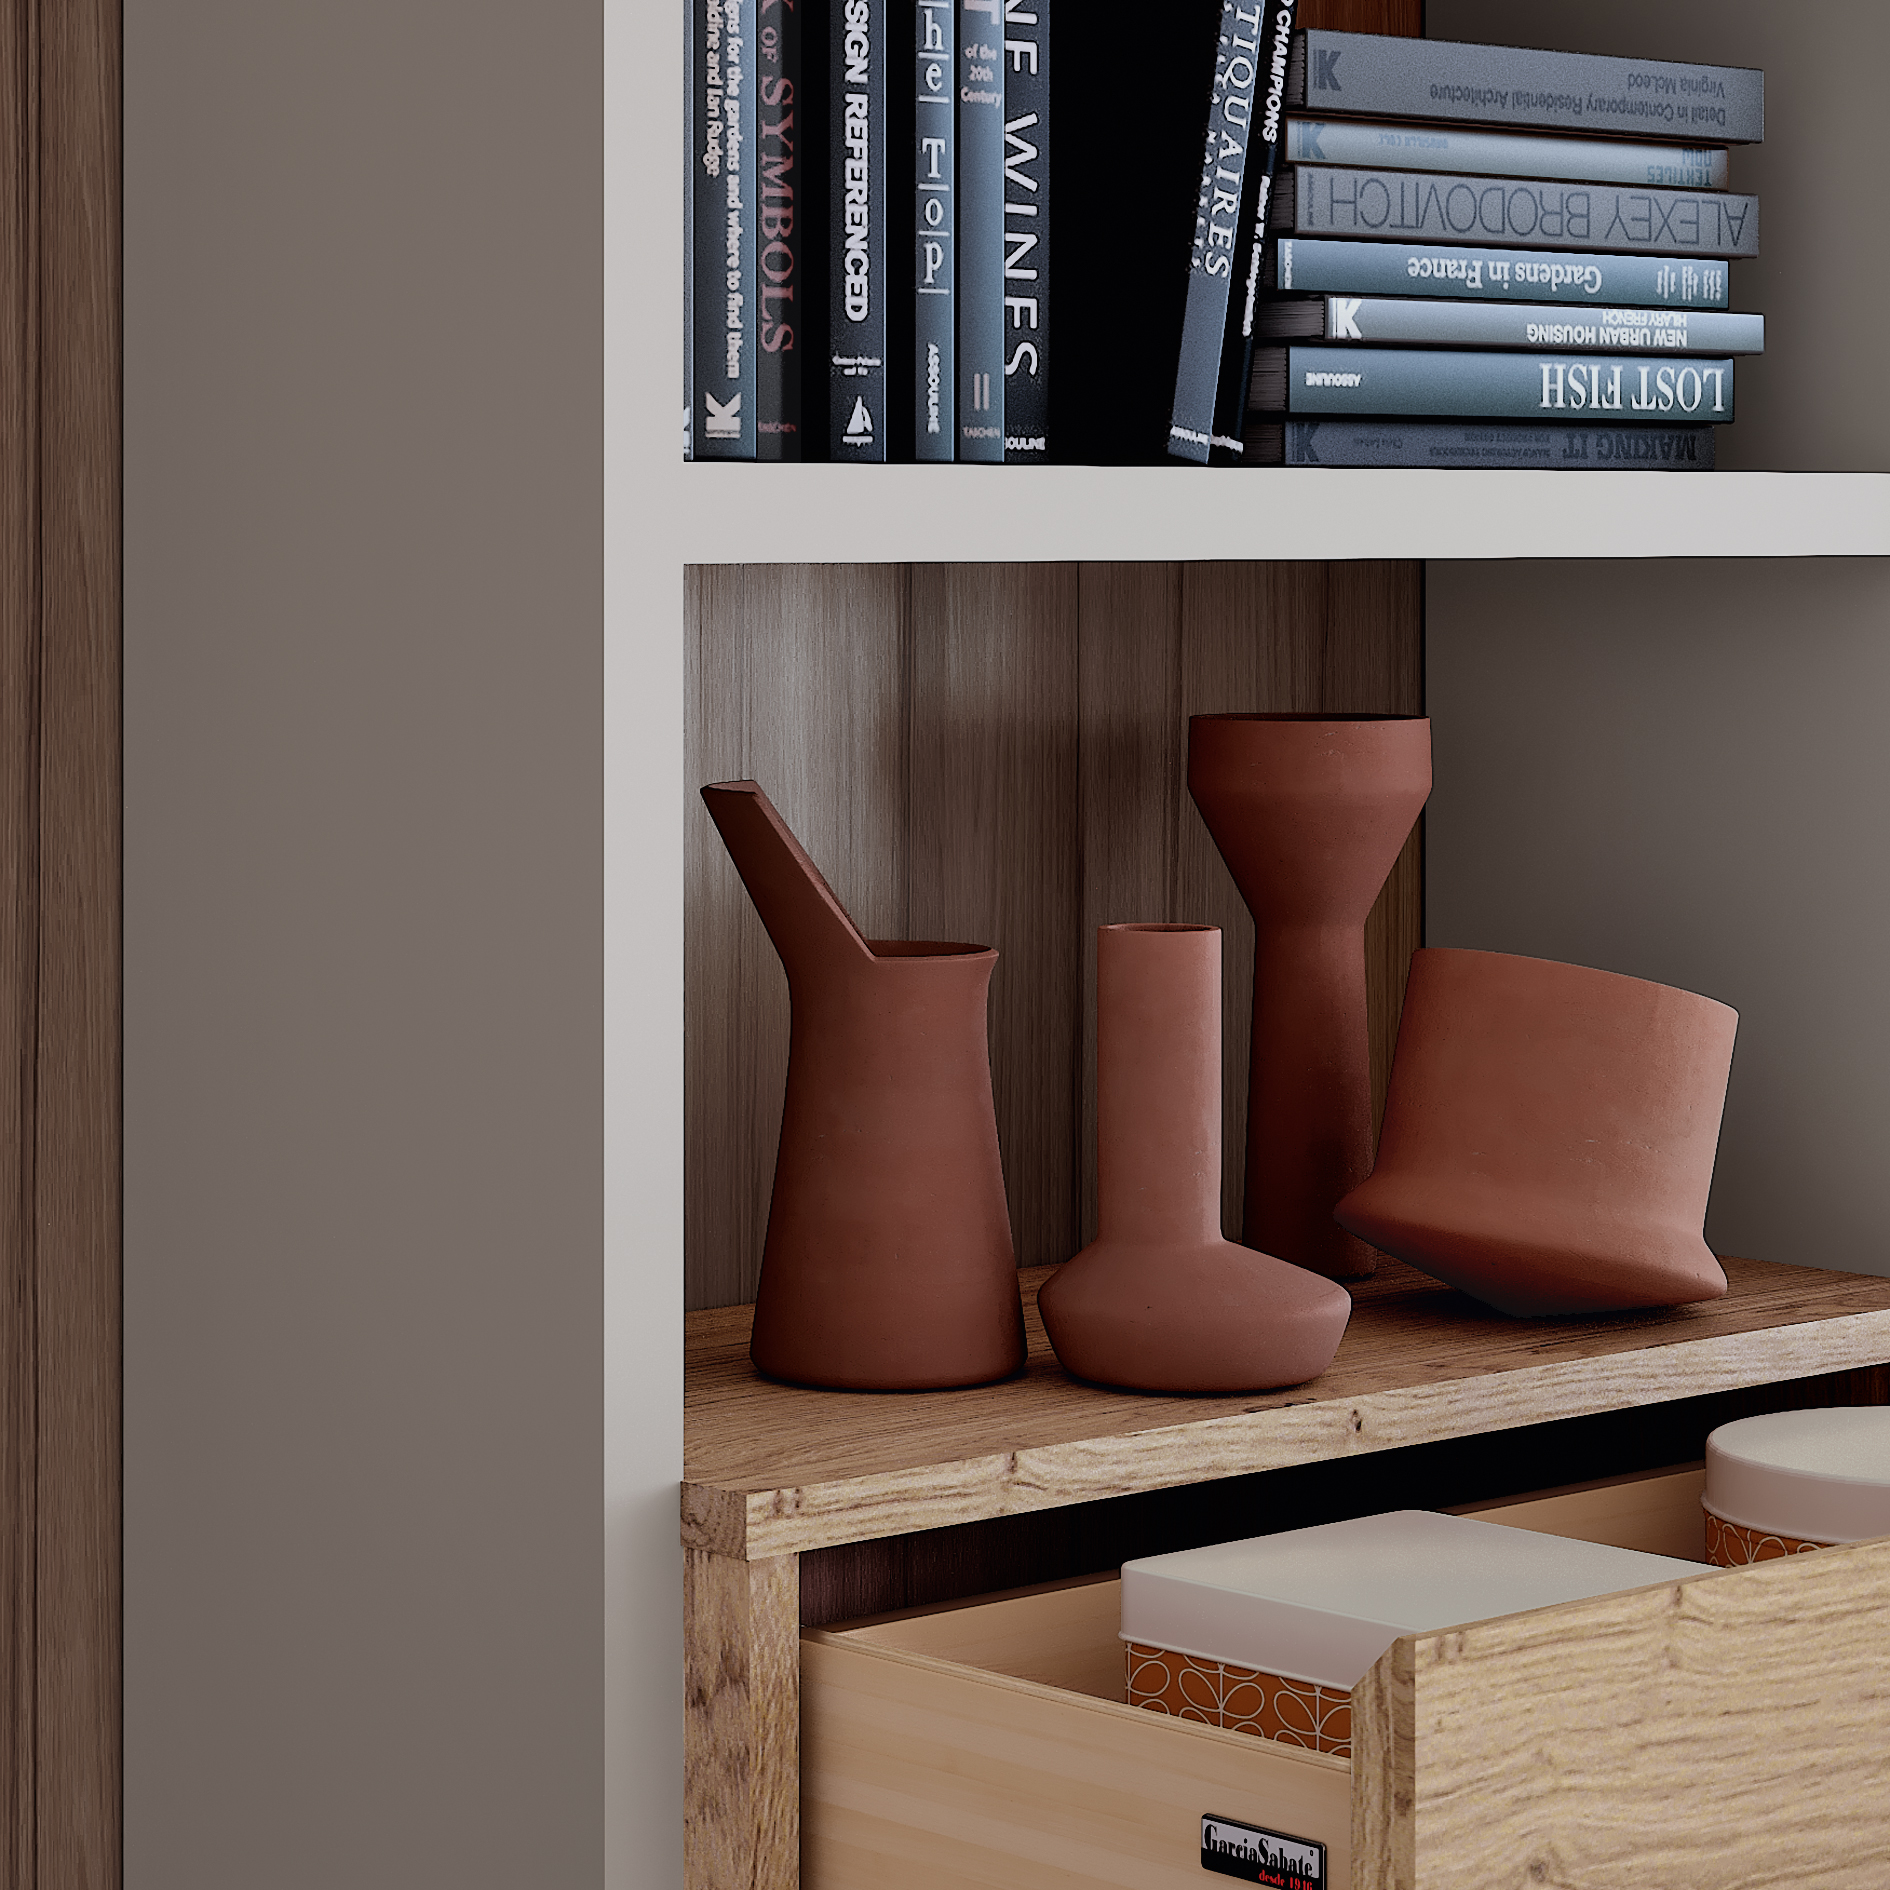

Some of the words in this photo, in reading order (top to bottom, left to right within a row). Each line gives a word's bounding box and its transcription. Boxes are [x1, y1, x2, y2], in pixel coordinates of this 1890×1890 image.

[762, 26, 778, 63] OF
[1262, 9, 1292, 144] CHAMPIONS
[1627, 73, 1676, 93] McLeod
[1680, 75, 1725, 97] Virginia
[1429, 84, 1509, 108] Architecture
[1512, 91, 1582, 117] Residential
[1586, 94, 1674, 122] Contemporary
[1677, 105, 1688, 123] in
[1692, 105, 1725, 126] Detail
[761, 76, 794, 352] SYMBOLS
[1330, 178, 1591, 239] BRODOVITCH
[1606, 195, 1749, 246] ALEXEY
[1407, 256, 1482, 289] France
[1488, 262, 1511, 282] in
[1515, 261, 1602, 294] Gardens
[1602, 310, 1646, 326] FRENCH
[1648, 312, 1688, 327] HILARY
[1527, 323, 1597, 344] HOUSING
[1599, 327, 1650, 346] URBAN
[1652, 329, 1687, 347] NEW
[1539, 362, 1623, 410] FISH
[1630, 365, 1725, 412] LOST
[1600, 432, 1698, 462] MAKING
[1259, 1869, 1285, 1887] desde
